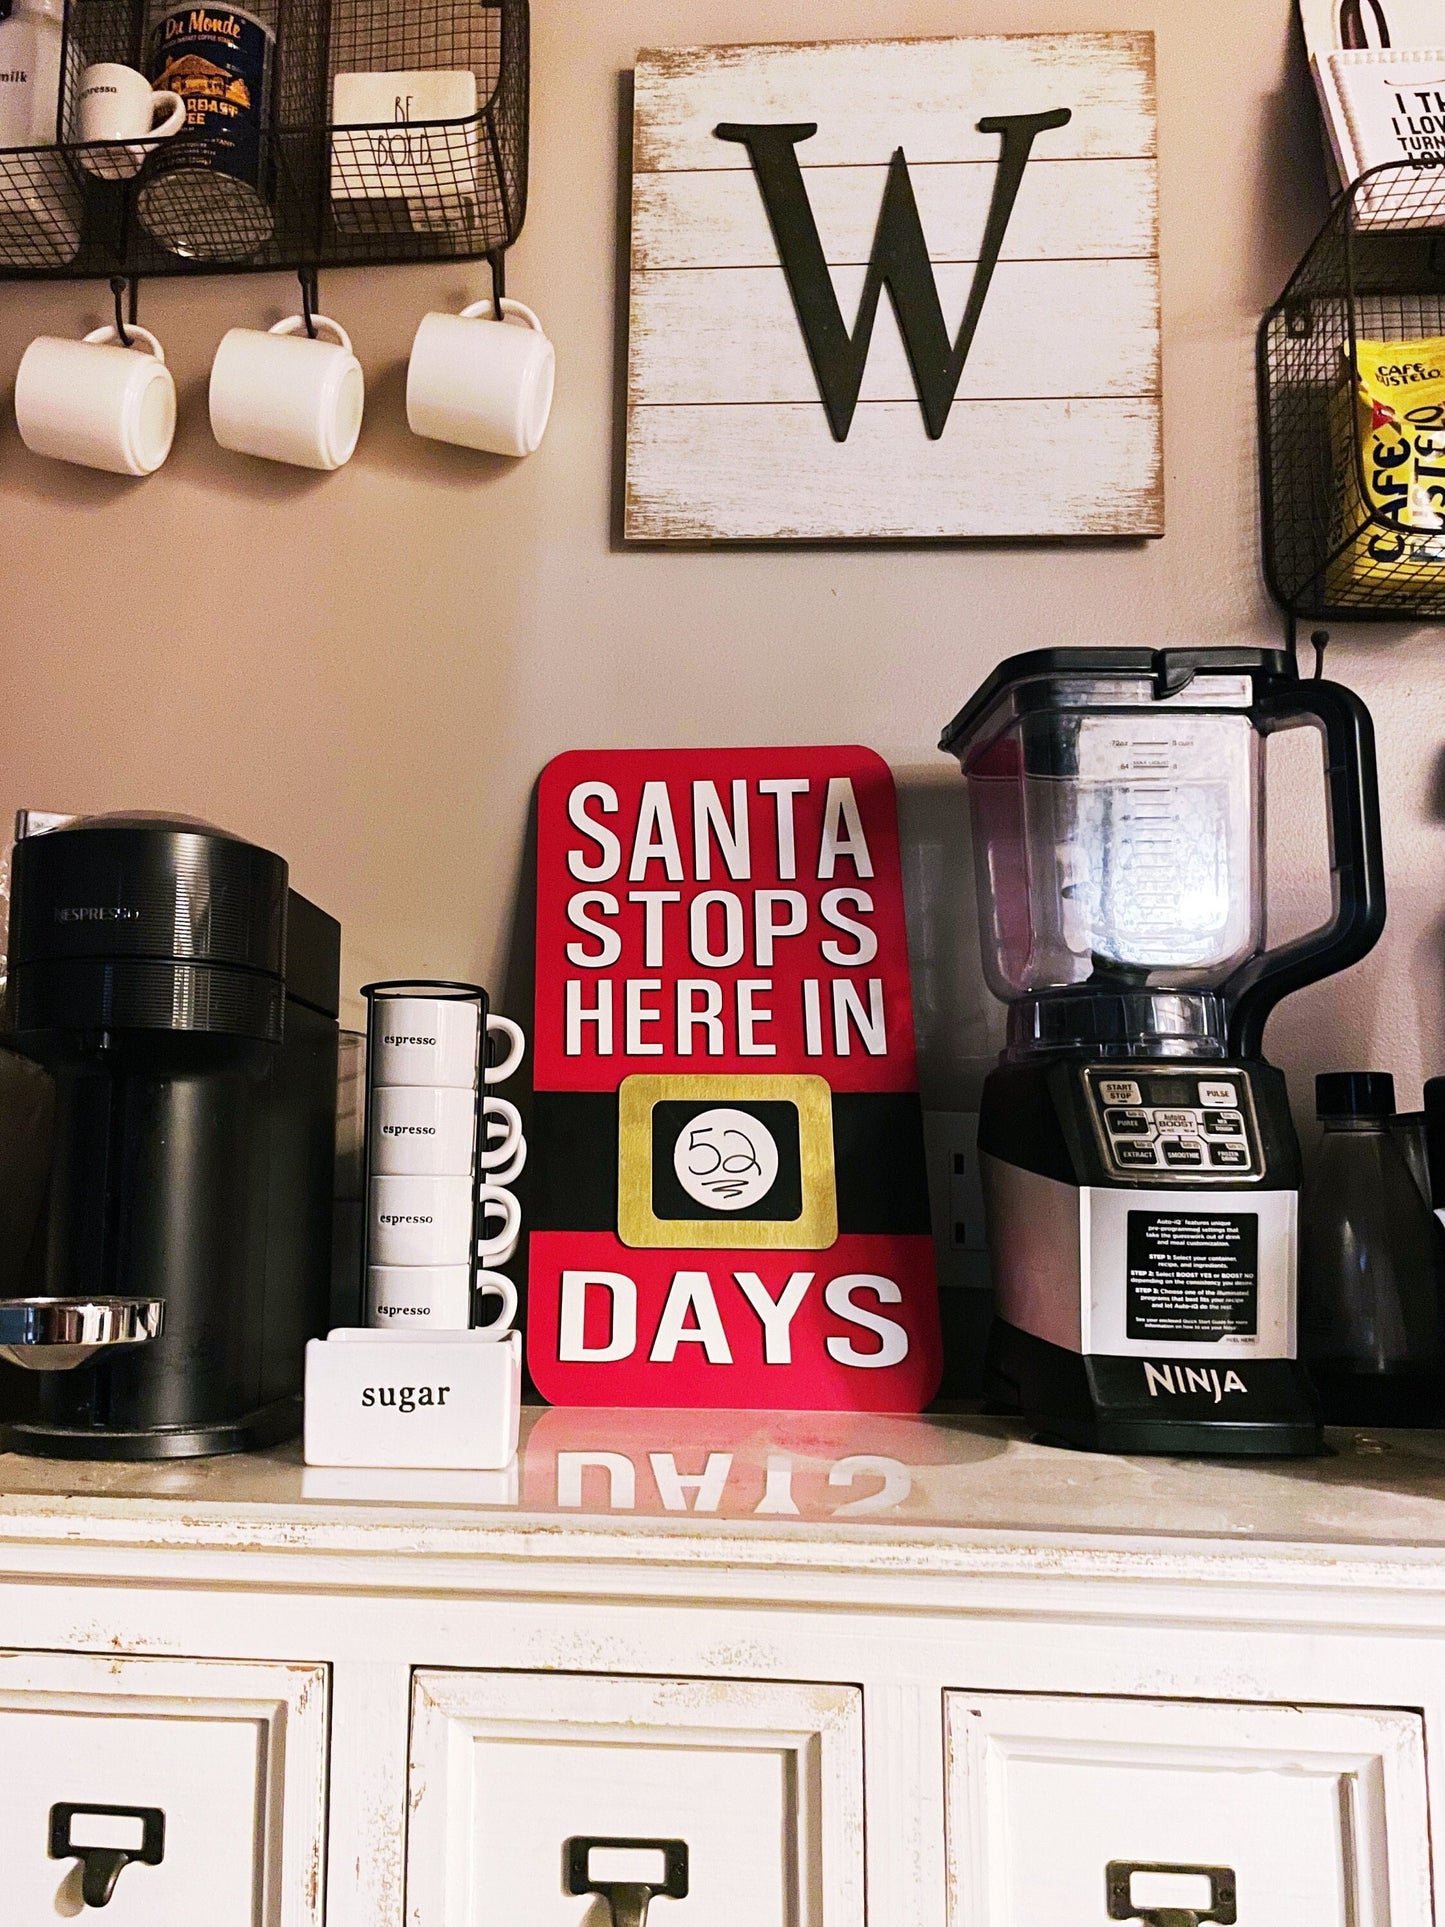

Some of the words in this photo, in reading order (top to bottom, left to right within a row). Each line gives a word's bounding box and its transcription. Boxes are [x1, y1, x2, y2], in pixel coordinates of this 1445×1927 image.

[165, 18, 184, 39] Du
[189, 10, 241, 38] Monde
[187, 99, 238, 117] ROAST
[1395, 93, 1406, 114] I
[1392, 117, 1401, 135] I
[377, 134, 432, 167] BOLD
[714, 108, 1073, 443] W
[567, 777, 875, 883] SANTA
[566, 888, 878, 968] STOPS
[566, 979, 777, 1056] HERE
[803, 978, 887, 1056] IN
[384, 1034, 437, 1047] espresso
[382, 1124, 437, 1137] espresso
[687, 1127, 762, 1176] 52
[379, 1214, 434, 1226] espresso
[377, 1304, 432, 1317] espresso
[559, 1271, 908, 1368] DAYS
[1143, 1361, 1248, 1404] NINJA
[361, 1385, 451, 1413] sugar
